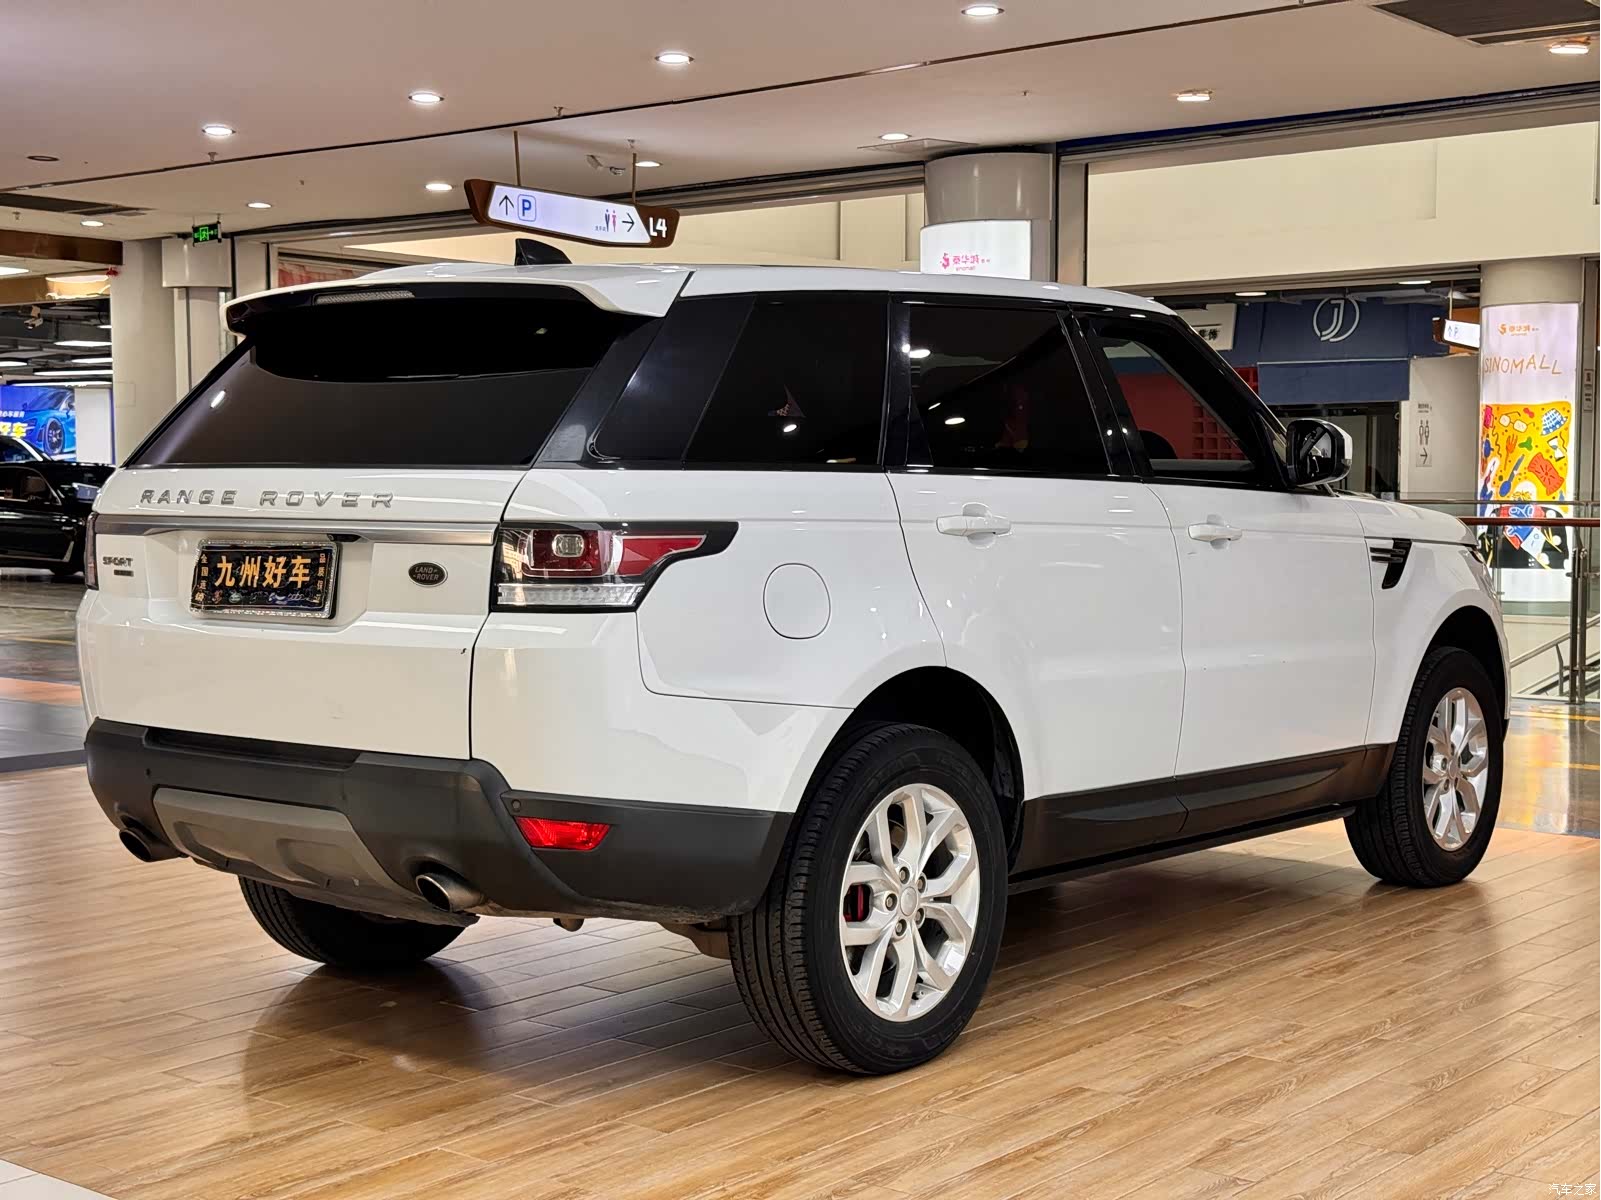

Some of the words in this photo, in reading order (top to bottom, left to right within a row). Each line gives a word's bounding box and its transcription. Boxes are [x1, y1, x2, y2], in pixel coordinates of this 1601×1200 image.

[521, 199, 532, 217] P
[649, 216, 667, 238] L4
[1484, 354, 1562, 375] SINOMALL
[140, 489, 237, 505] RANGE
[258, 490, 394, 508] ROVER
[102, 556, 134, 568] SPORT
[414, 566, 434, 574] LAND
[214, 555, 312, 588] 九州好车
[416, 573, 439, 581] ROVER
